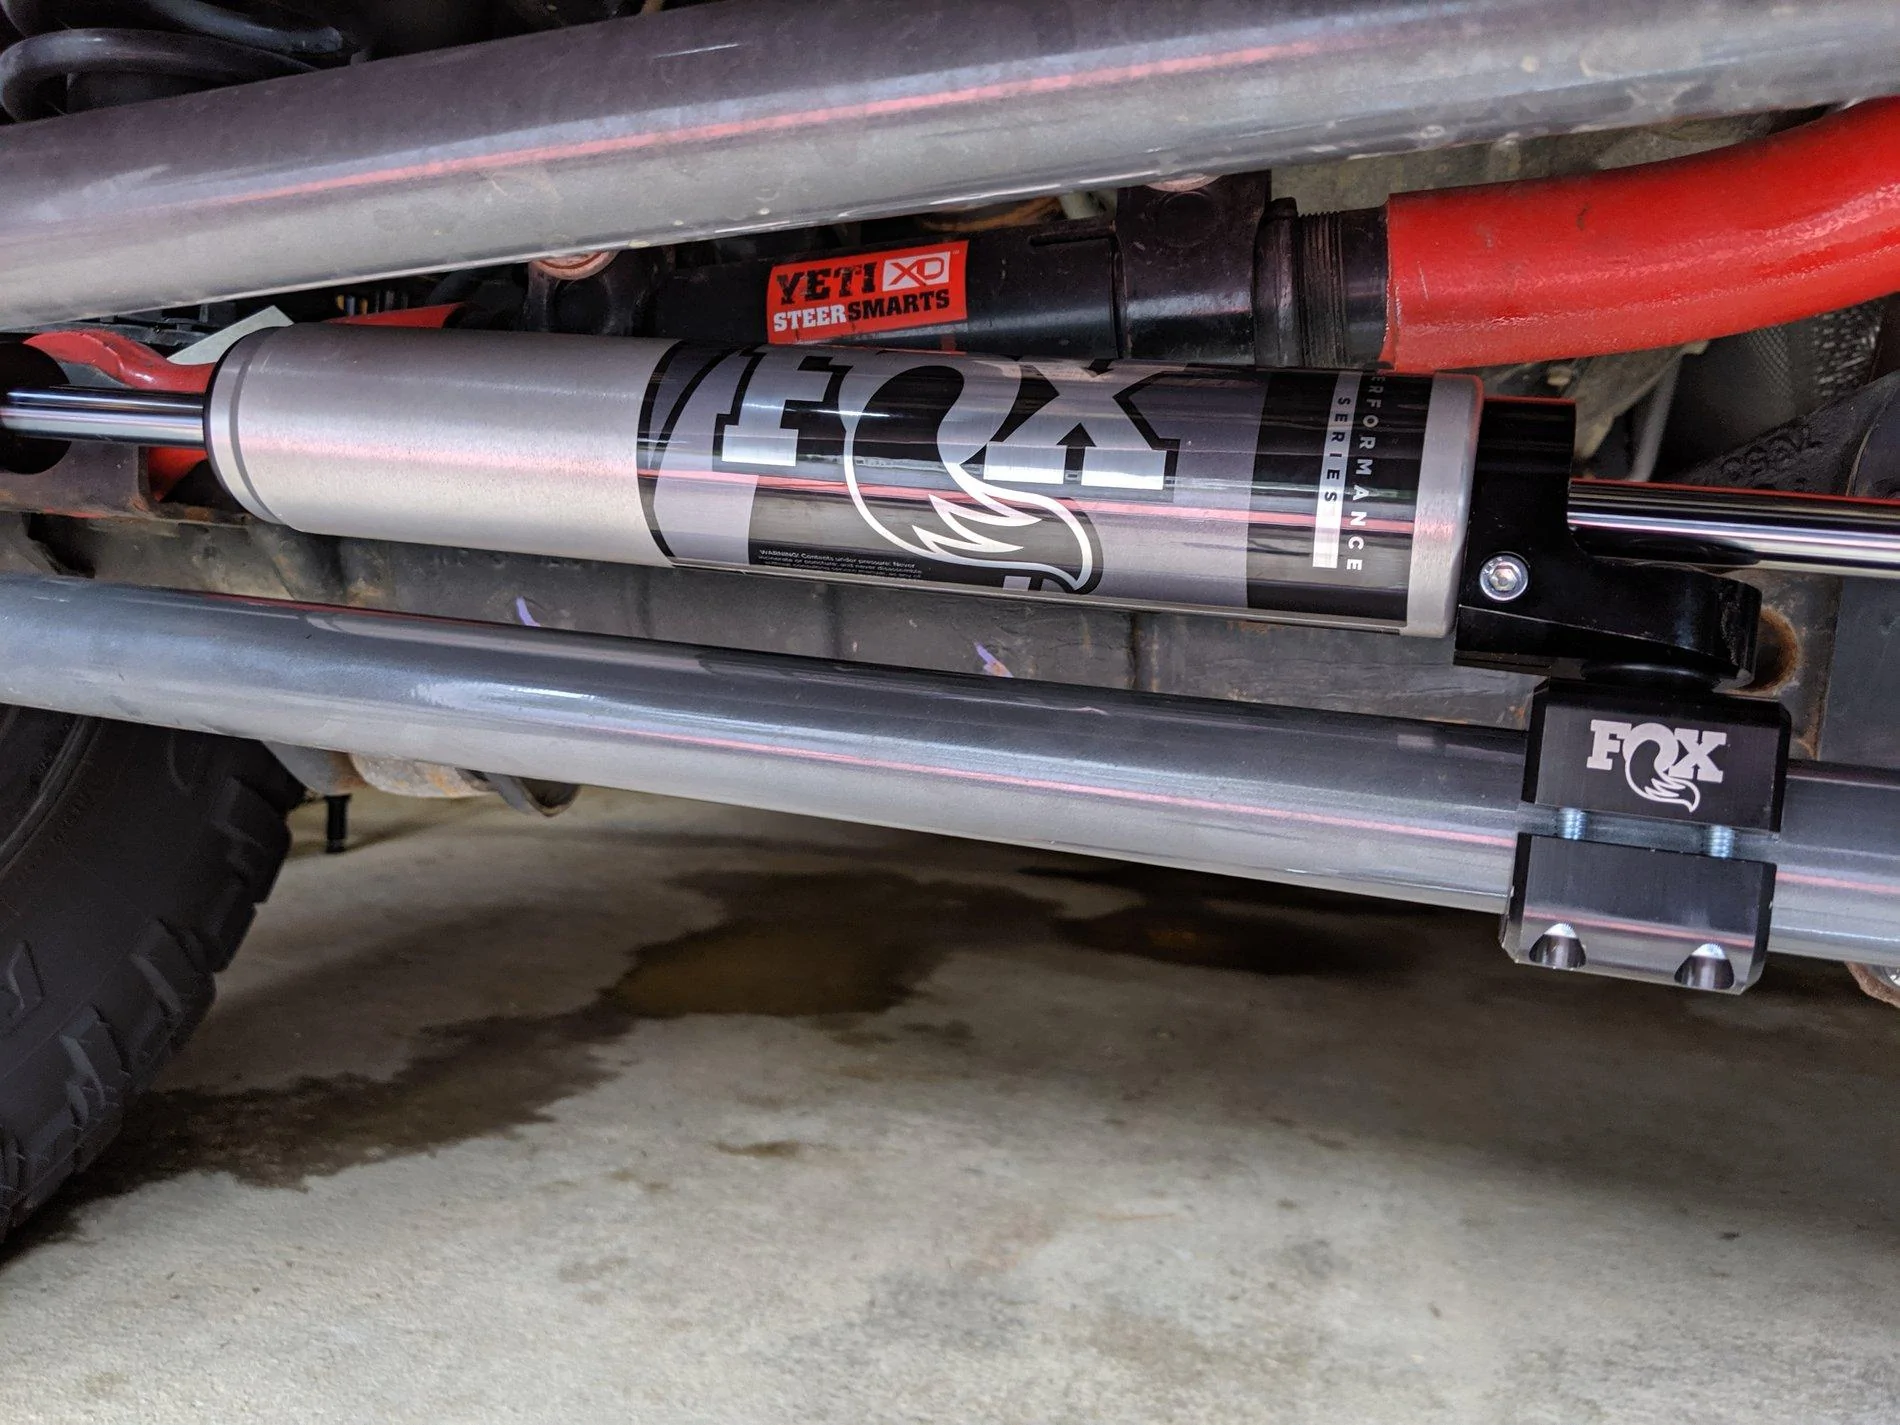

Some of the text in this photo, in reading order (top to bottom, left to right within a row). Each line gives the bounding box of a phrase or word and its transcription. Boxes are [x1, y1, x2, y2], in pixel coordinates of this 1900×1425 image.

[776, 261, 878, 305] YETI
[722, 350, 1186, 590] FOX
[1324, 396, 1350, 502] SERIES
[1346, 375, 1386, 571] ERFORMANCE
[1586, 719, 1727, 812] FOX
